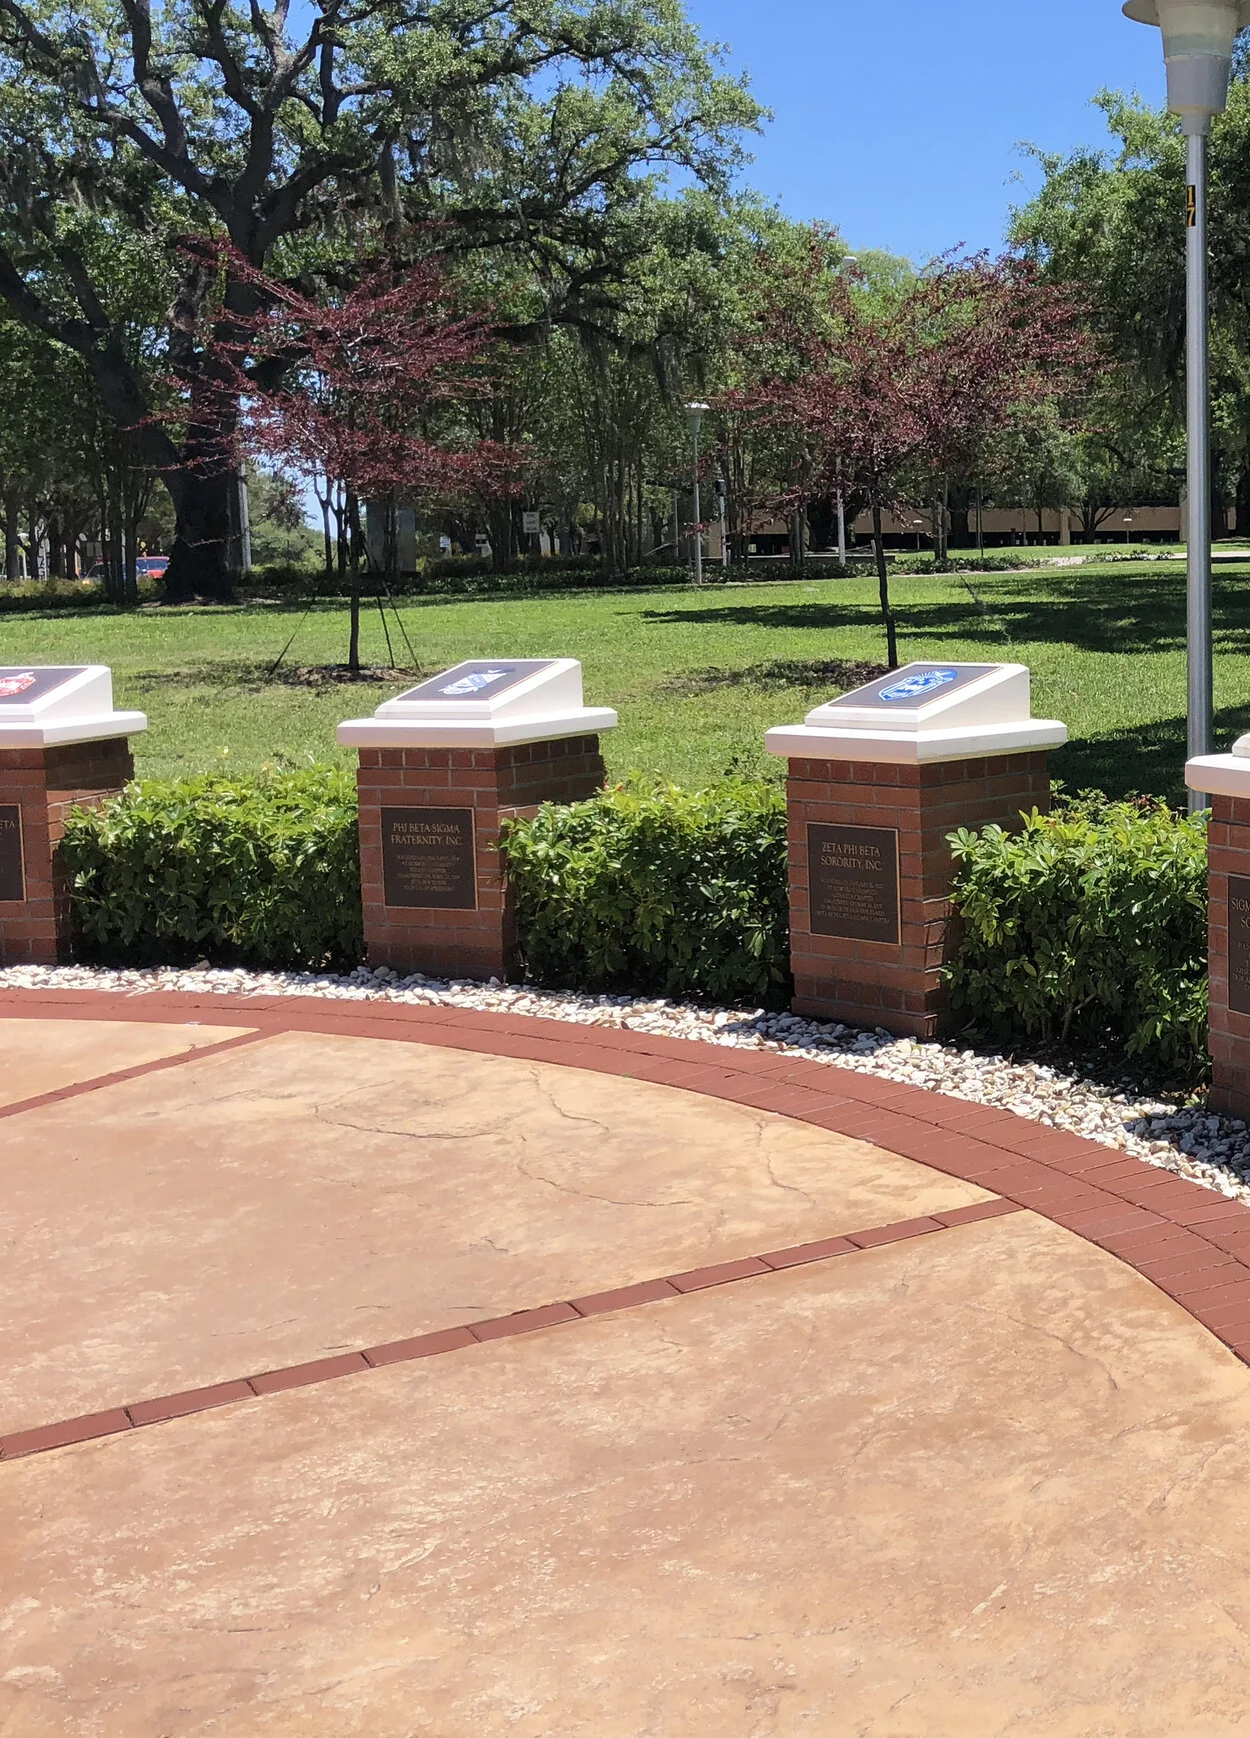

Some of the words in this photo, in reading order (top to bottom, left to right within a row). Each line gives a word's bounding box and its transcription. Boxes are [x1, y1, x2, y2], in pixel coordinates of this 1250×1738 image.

[393, 823, 408, 832] PHI
[409, 823, 430, 832] BETA
[432, 823, 460, 833] SIGMA
[446, 836, 463, 845] INC.
[821, 842, 842, 853] ZETA
[844, 844, 858, 854] PHI
[860, 845, 880, 857] BETA
[865, 860, 883, 871] INC.
